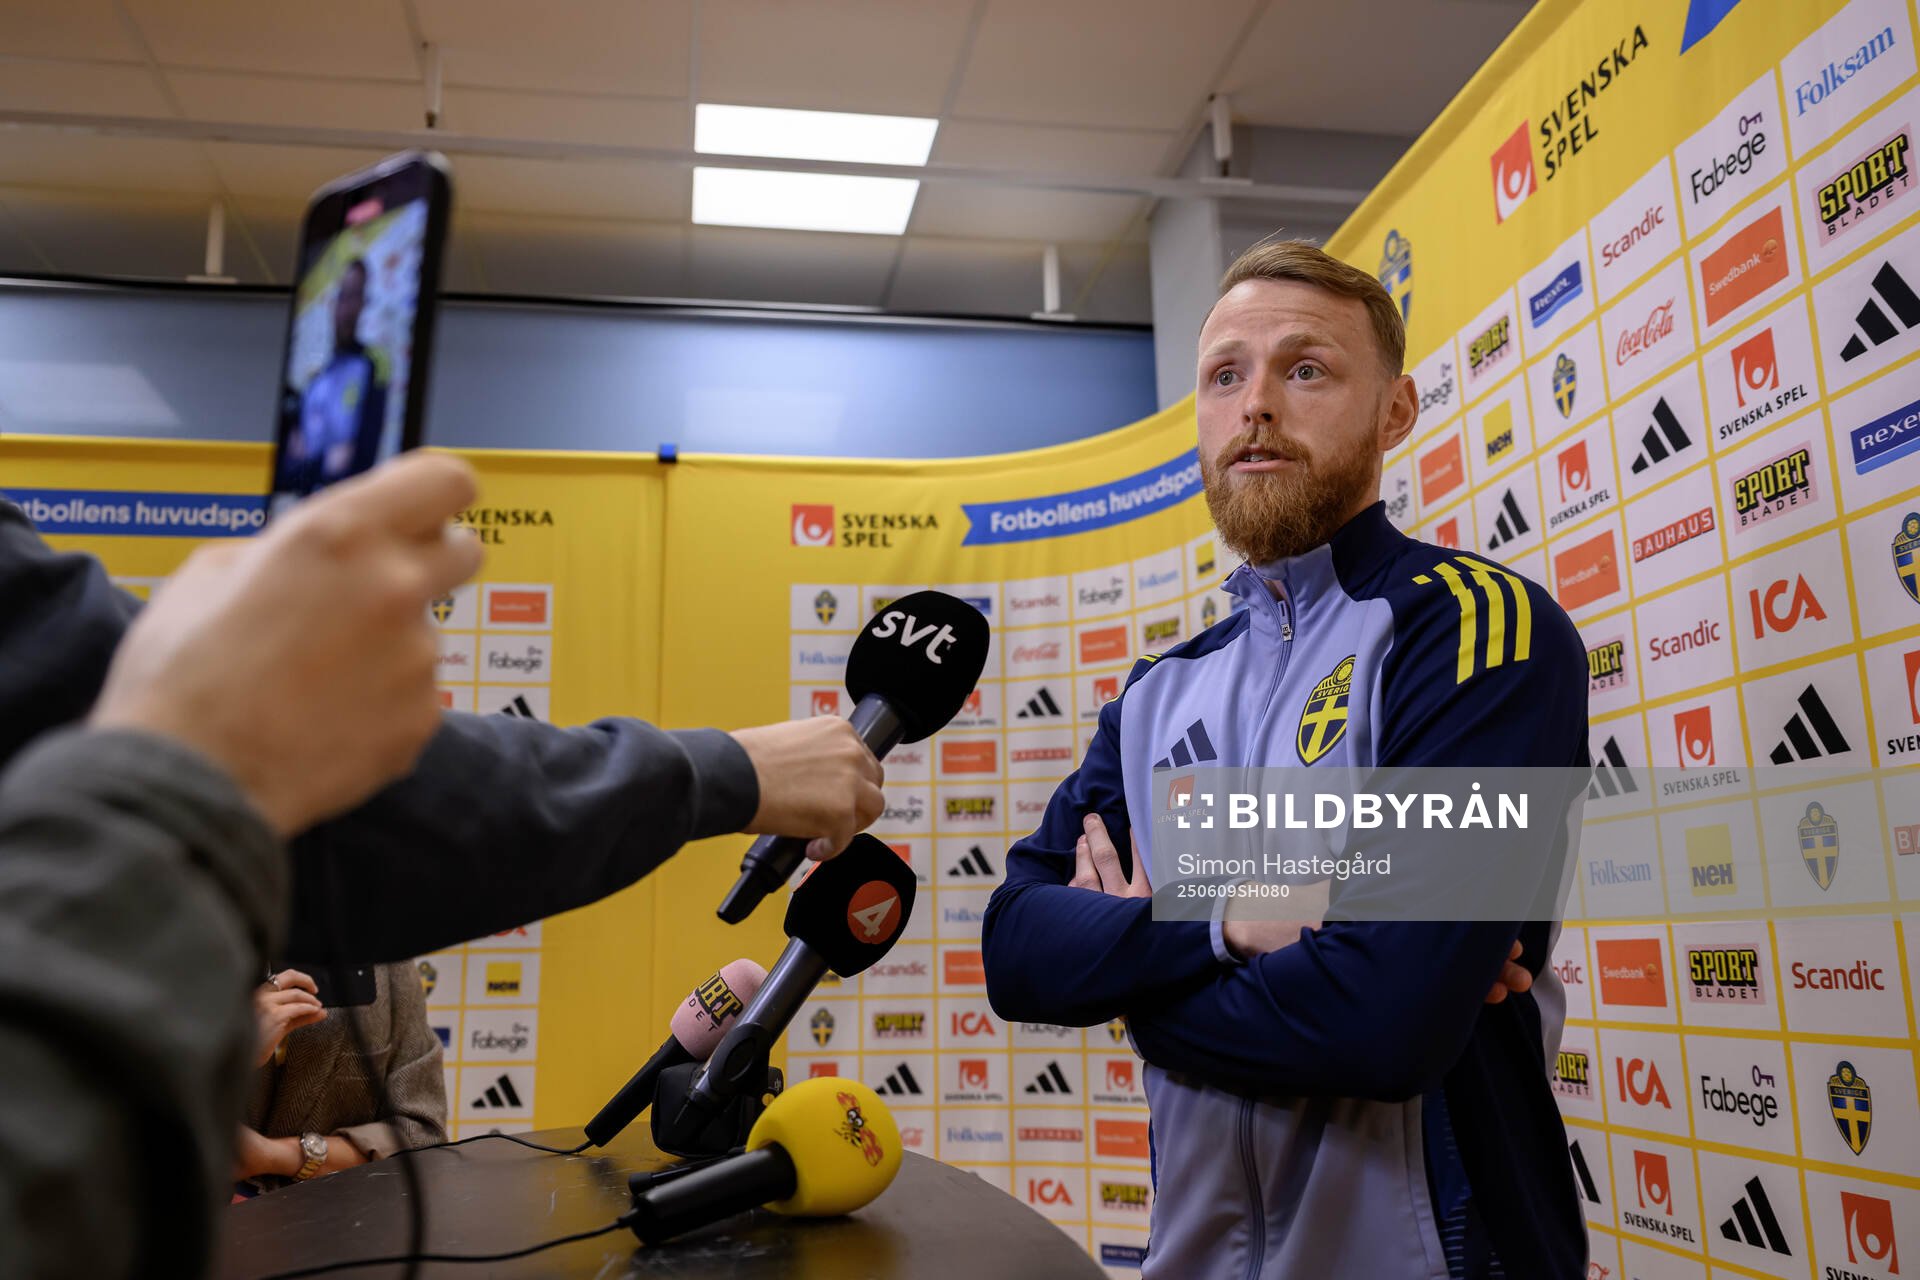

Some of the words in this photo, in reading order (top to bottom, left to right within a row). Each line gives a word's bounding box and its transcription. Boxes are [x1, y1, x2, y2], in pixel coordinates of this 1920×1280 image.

[1540, 24, 1649, 149] SVENSKA
[1795, 26, 1896, 118] Folksam
[1544, 114, 1598, 182] SPEL
[1690, 131, 1766, 204] Fabege
[1818, 133, 1909, 226] SPORT
[1828, 175, 1911, 236] BLADET
[1602, 204, 1665, 268] Scandic
[1709, 253, 1760, 296] Swedbank
[1468, 314, 1510, 369] SPORT
[1420, 379, 1453, 413] bege
[1720, 402, 1773, 440] SVENSKA
[1776, 384, 1808, 410] SPEL
[1734, 449, 1810, 515] SPORT
[17, 498, 130, 524] tbollens
[453, 509, 554, 526] SVENSKA
[842, 514, 939, 530] SVENSKA
[990, 498, 1108, 534] Fotbollens
[1550, 501, 1588, 528] SVENSKA
[1589, 489, 1610, 508] SPEL
[1741, 488, 1810, 526] BLADET
[842, 531, 893, 547] SPEL
[1633, 507, 1714, 563] BAUHAUS
[1749, 572, 1827, 639] ICA
[872, 611, 957, 665] svt
[1650, 619, 1720, 661] Scandic
[488, 651, 543, 673] Fabege
[1589, 640, 1623, 679] ORT
[1316, 684, 1350, 698] SVERIG
[1591, 674, 1624, 691] ADET
[1664, 775, 1710, 796] SVENSKA
[1713, 769, 1741, 786] SPEL
[1590, 860, 1651, 886] Folksam
[852, 896, 898, 938] 4
[1603, 966, 1645, 979] Swedbank
[1689, 949, 1758, 987] SPORT
[1792, 961, 1885, 991] Scandic
[1696, 988, 1759, 999] BLADET
[471, 1030, 529, 1053] Fabege
[952, 1012, 995, 1037] ICA
[1553, 1052, 1589, 1085] ORT
[1616, 1056, 1672, 1109] ICA
[1553, 1086, 1589, 1096] LADET
[1701, 1075, 1778, 1127] Fabege
[1027, 1179, 1073, 1206] ICA
[1624, 1211, 1668, 1237] SVENSKA
[1670, 1223, 1695, 1244] SPEL
